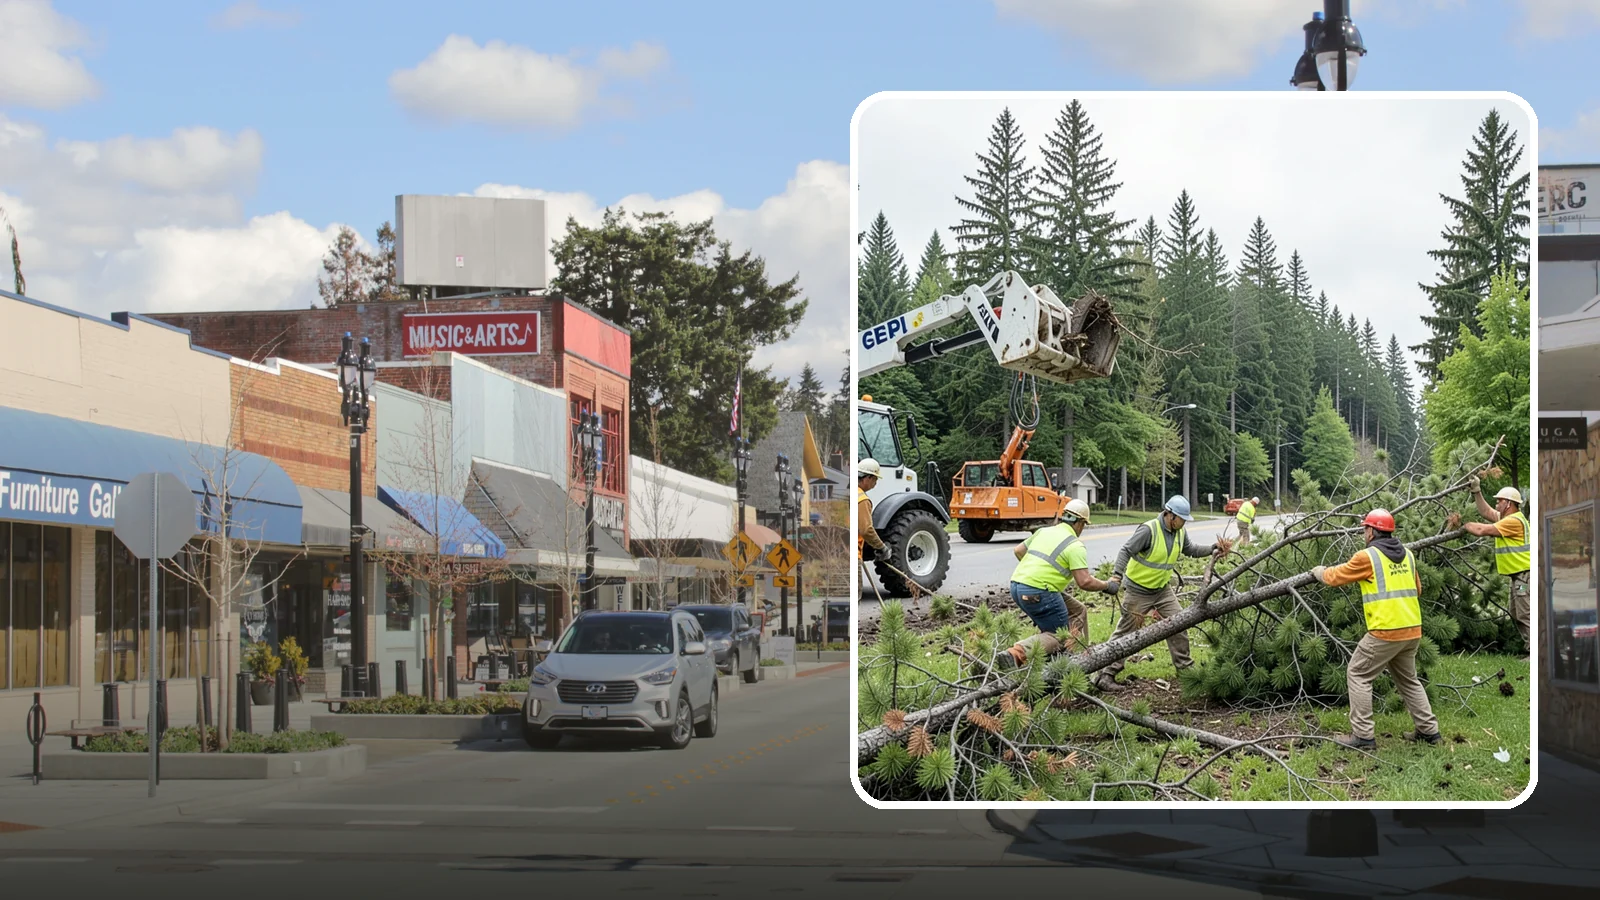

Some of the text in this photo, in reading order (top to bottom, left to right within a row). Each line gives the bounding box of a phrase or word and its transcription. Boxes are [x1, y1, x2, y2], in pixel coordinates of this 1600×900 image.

[409, 323, 519, 348] MUSIC&ARTS
[0, 471, 122, 519] Furniture Gal
[453, 563, 479, 574] SUSHI
